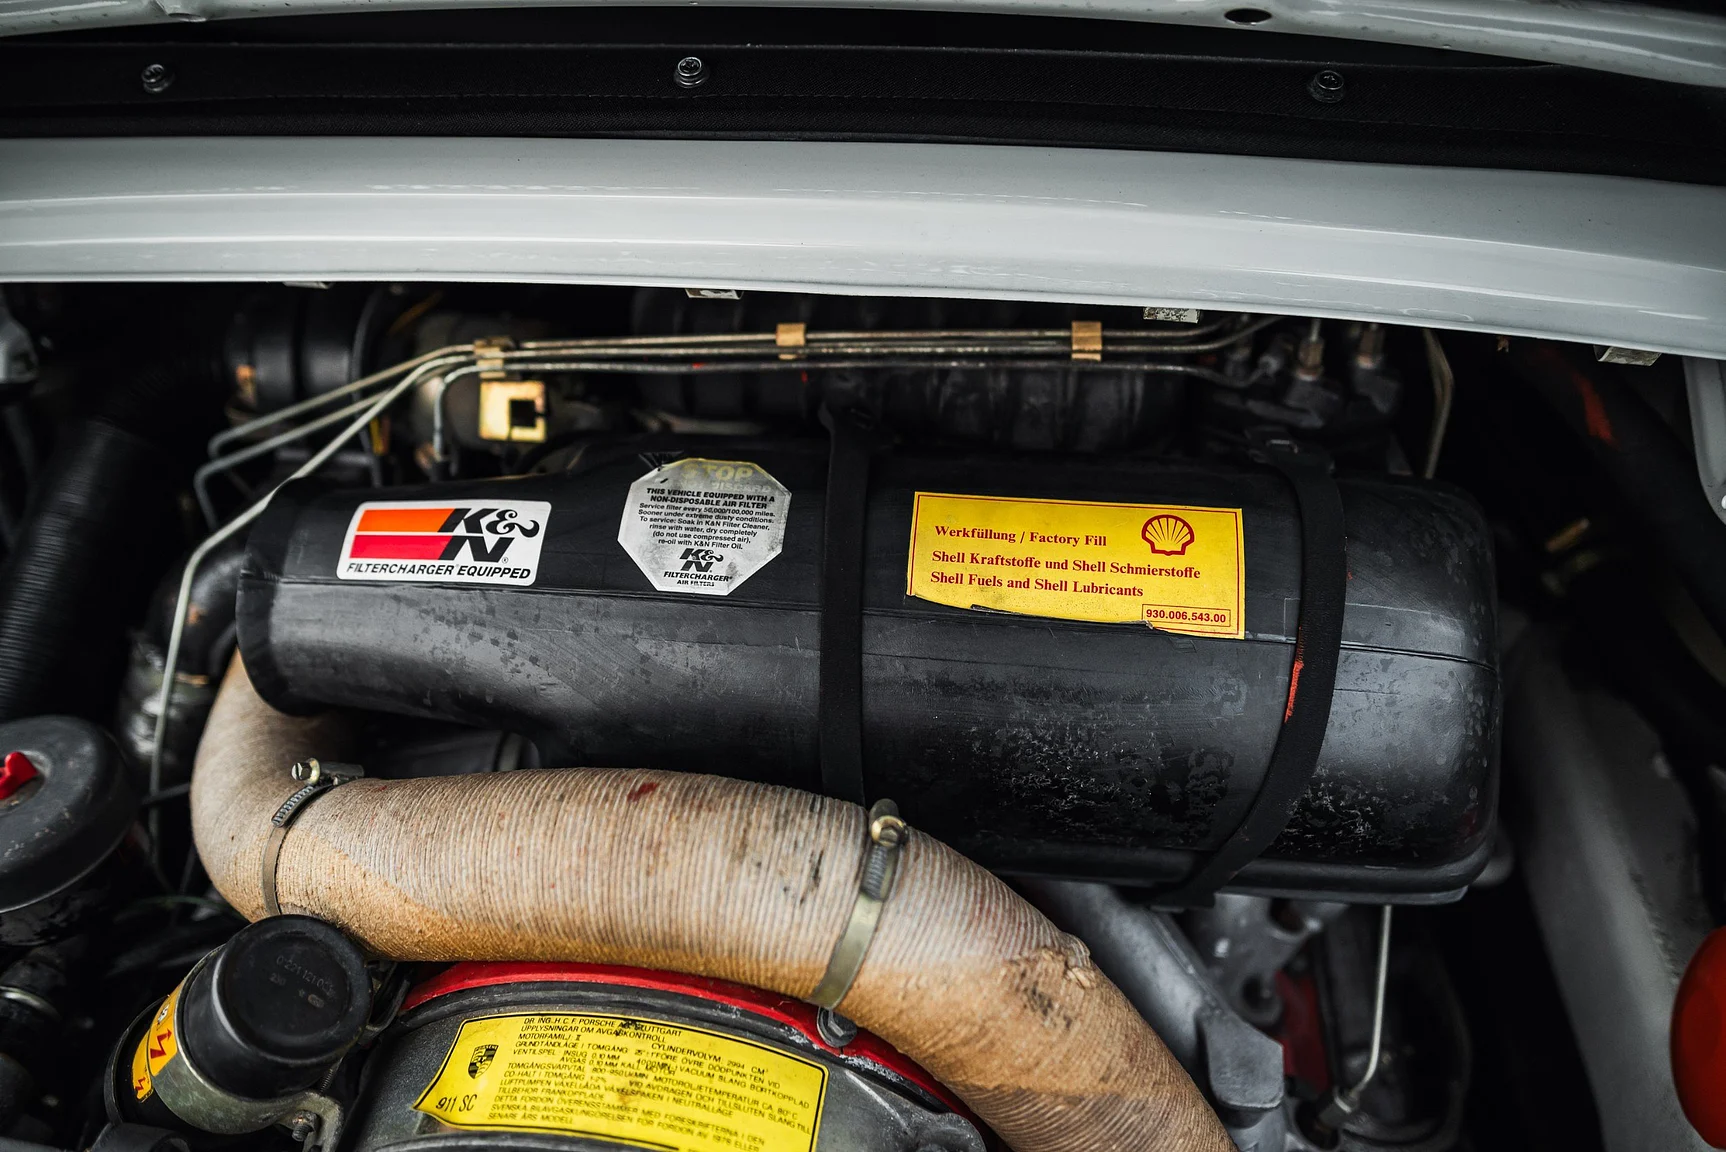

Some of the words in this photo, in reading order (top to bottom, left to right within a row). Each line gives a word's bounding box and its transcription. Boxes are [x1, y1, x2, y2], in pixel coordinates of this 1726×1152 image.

[650, 495, 720, 506] NON-DISPOSABLE
[668, 489, 701, 497] VEHICLE
[719, 529, 757, 537] completely
[935, 525, 1016, 543] Werkfüllung
[1020, 531, 1025, 544] /
[1029, 531, 1080, 547] Factory
[1085, 535, 1107, 546] Fill
[932, 550, 965, 563] Shell
[969, 553, 1041, 568] Kraftstoffe
[1045, 559, 1068, 571] und
[1072, 560, 1106, 573] Shell
[1110, 562, 1200, 578] Schmierstoffe
[457, 565, 531, 579] EQUIPPED
[930, 571, 964, 585] Shell
[968, 573, 1003, 588] Fuels
[1007, 577, 1030, 589] and
[1034, 578, 1068, 592] Shell
[1072, 581, 1144, 597] Lubricants
[1146, 609, 1226, 623] 930.006.543.00
[579, 1018, 615, 1027] PORSCHE
[596, 1027, 666, 1043] AVGASKONTROLL
[679, 1065, 714, 1078] VACUUM
[718, 1075, 746, 1088] SLANG
[768, 1080, 780, 1089] VID
[436, 1096, 457, 1112] 911
[459, 1094, 478, 1112] SC
[629, 1080, 643, 1088] VID
[696, 1093, 714, 1102] OCH
[768, 1113, 795, 1128] SLANG
